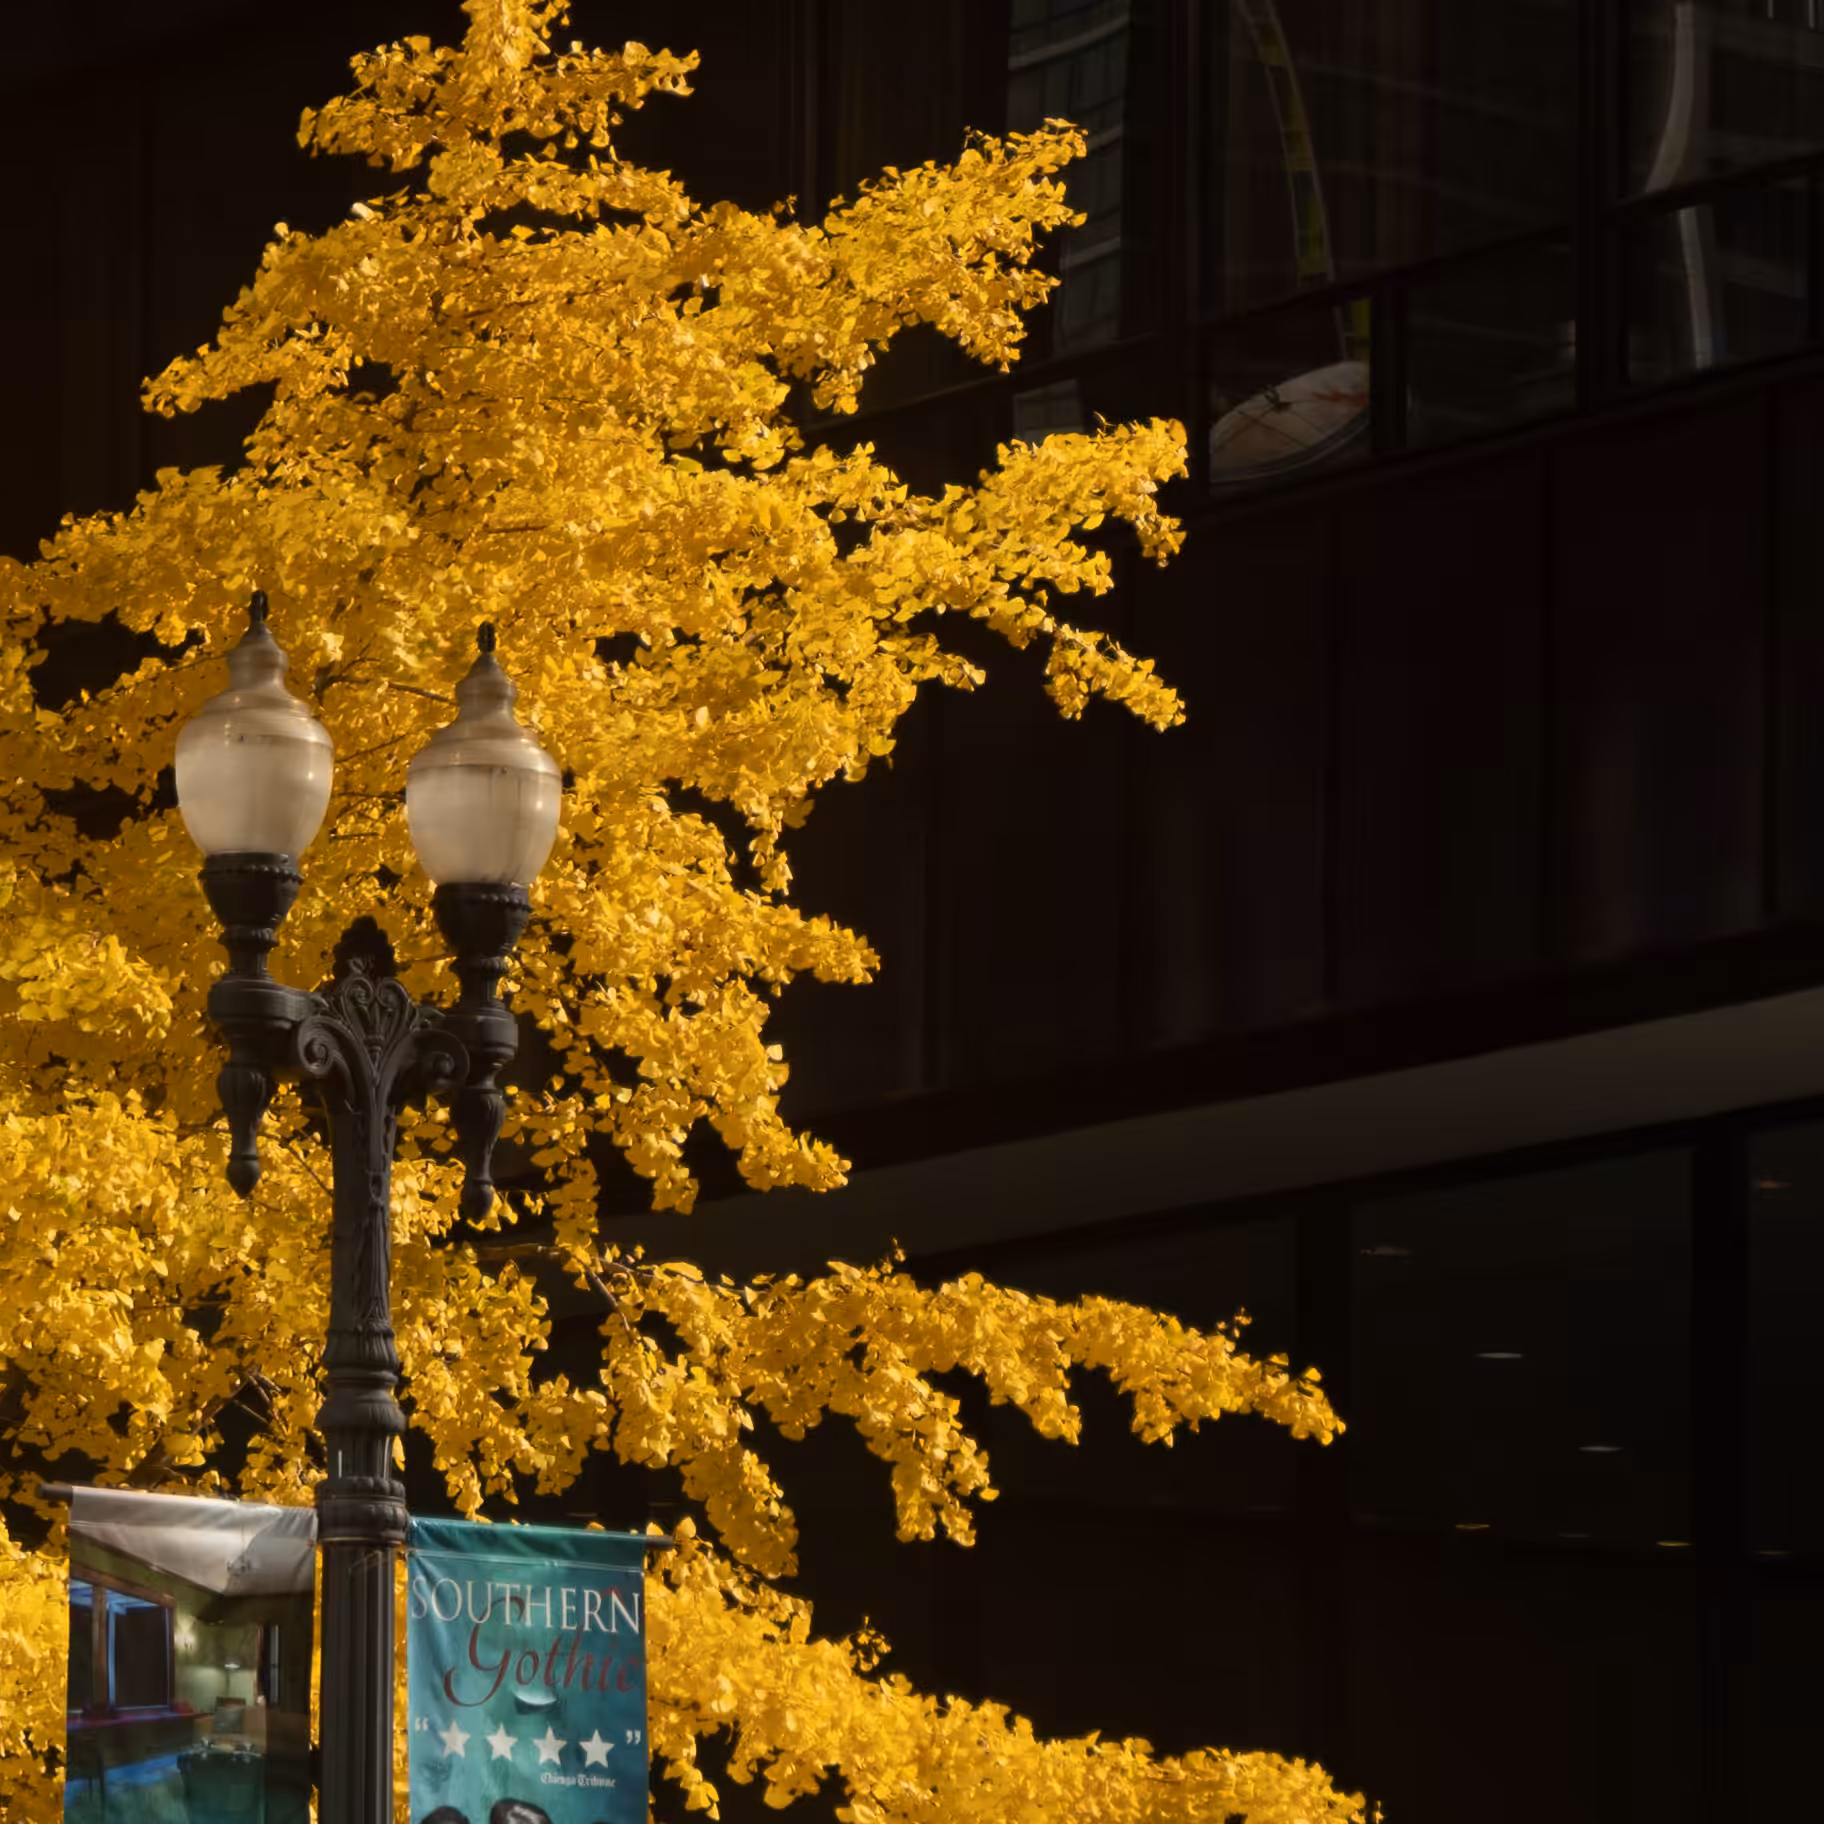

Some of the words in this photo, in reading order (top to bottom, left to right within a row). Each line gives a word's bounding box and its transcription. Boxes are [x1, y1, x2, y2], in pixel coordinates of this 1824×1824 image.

[411, 1575, 640, 1634] SOUTHERN
[443, 1588, 641, 1707] Gothic
[577, 1773, 616, 1787] Tribune
